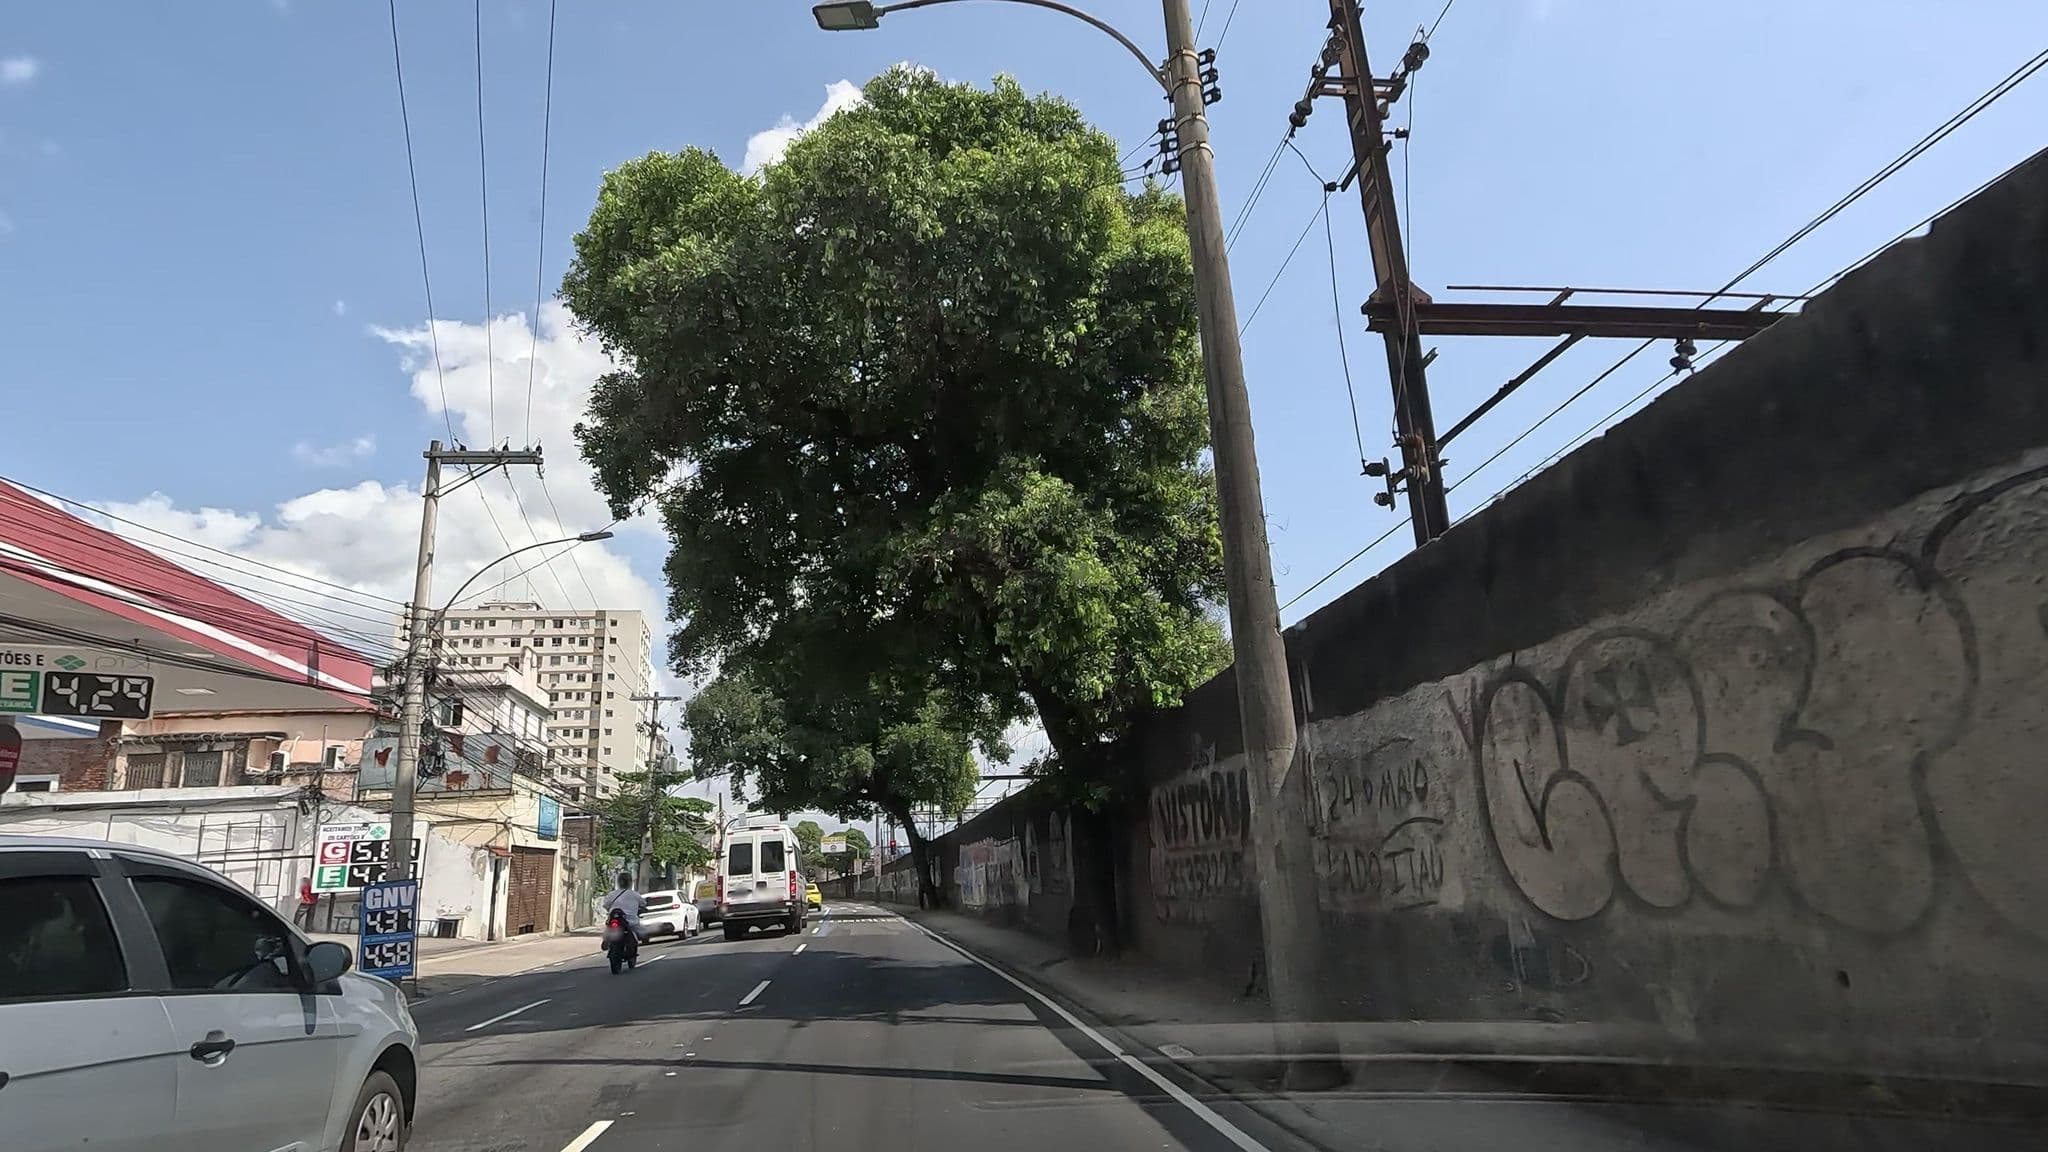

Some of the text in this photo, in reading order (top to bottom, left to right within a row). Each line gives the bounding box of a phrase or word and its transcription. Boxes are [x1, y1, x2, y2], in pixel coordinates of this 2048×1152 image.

[36, 654, 45, 667] E
[1, 672, 148, 714] E 4.29
[324, 842, 347, 860] G
[322, 867, 341, 883] E
[366, 885, 417, 909] GNV
